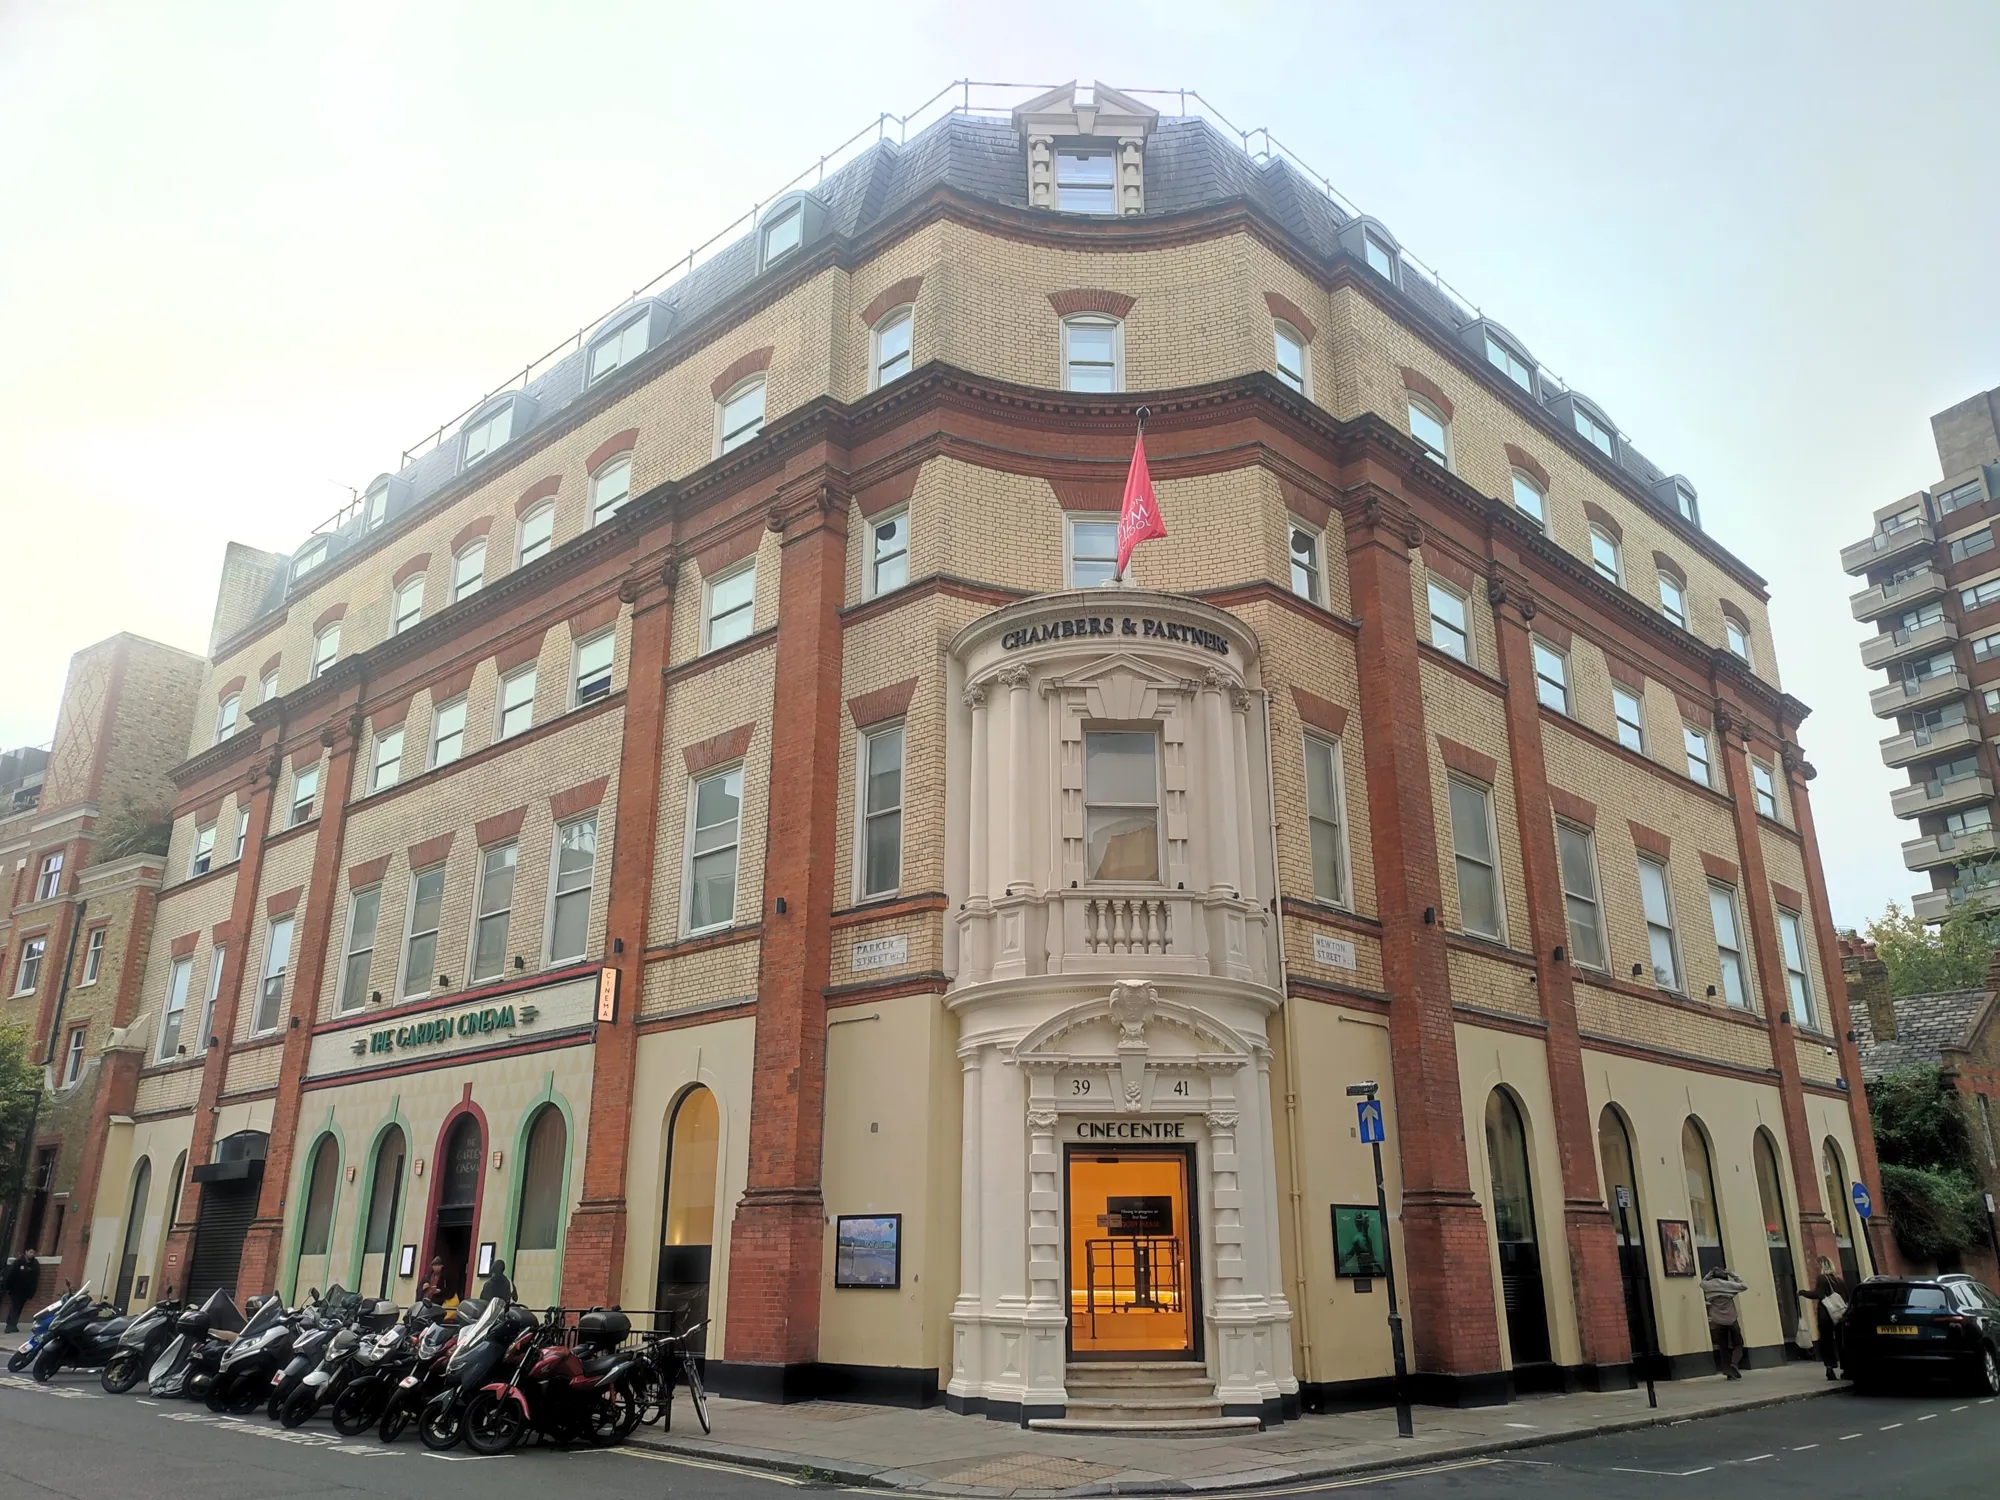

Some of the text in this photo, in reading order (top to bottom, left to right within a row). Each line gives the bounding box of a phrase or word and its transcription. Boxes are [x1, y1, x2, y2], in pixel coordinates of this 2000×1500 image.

[1001, 617, 1230, 655] CHAMBERS & PARTNERS
[856, 940, 894, 955] PARKER
[1315, 937, 1346, 953] NEWTON
[856, 951, 889, 967] STREET
[1317, 949, 1341, 963] STREET
[602, 972, 612, 1017] CINEMA
[369, 1004, 516, 1053] THE GARDEN CINEMA
[1072, 1079, 1189, 1096] 39 41
[1076, 1122, 1185, 1138] CINECENTRE
